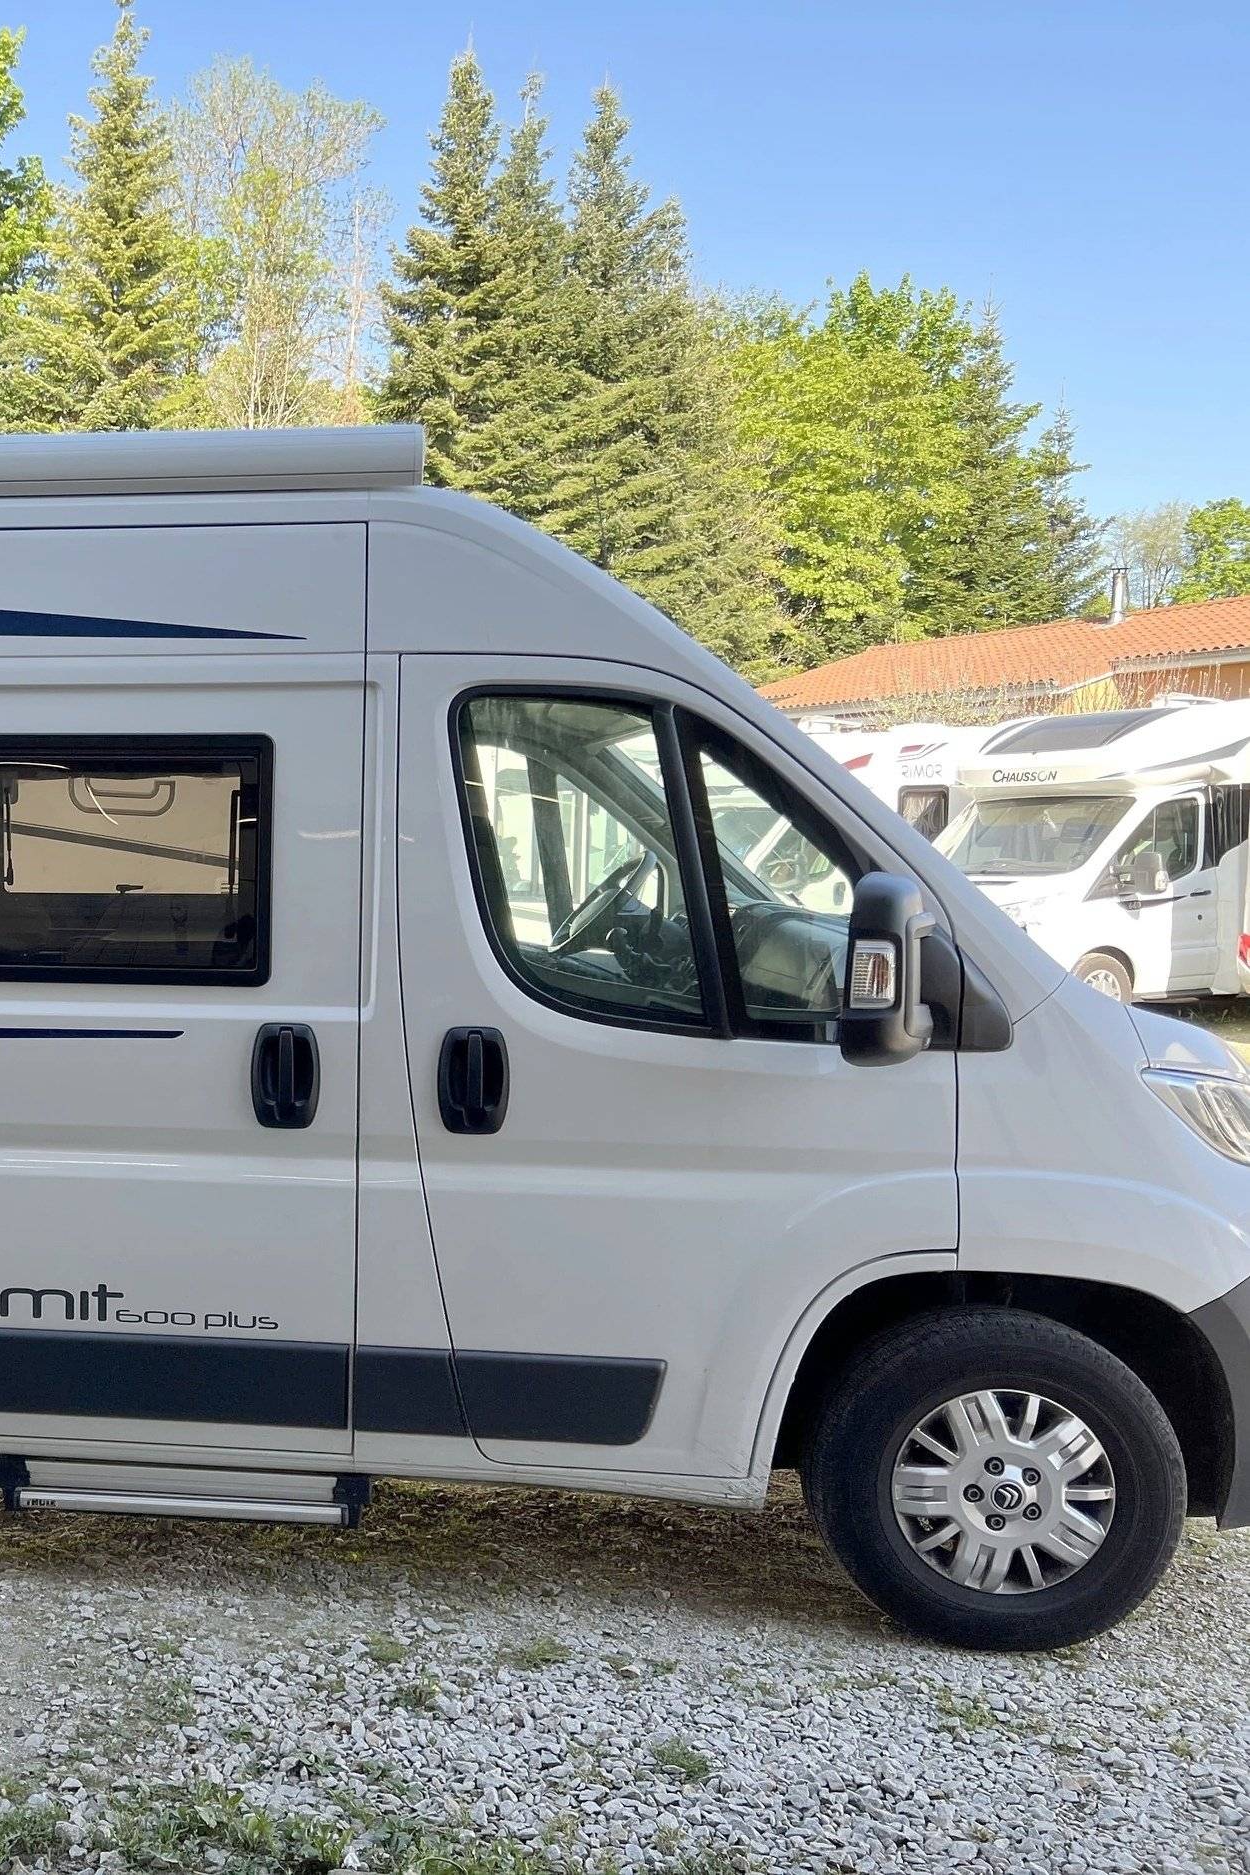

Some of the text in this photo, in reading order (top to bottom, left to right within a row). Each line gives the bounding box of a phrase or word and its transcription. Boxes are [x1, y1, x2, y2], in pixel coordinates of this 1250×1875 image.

[901, 763, 943, 779] RIMOR
[116, 1309, 196, 1326] 600
[204, 1310, 279, 1330] plus
